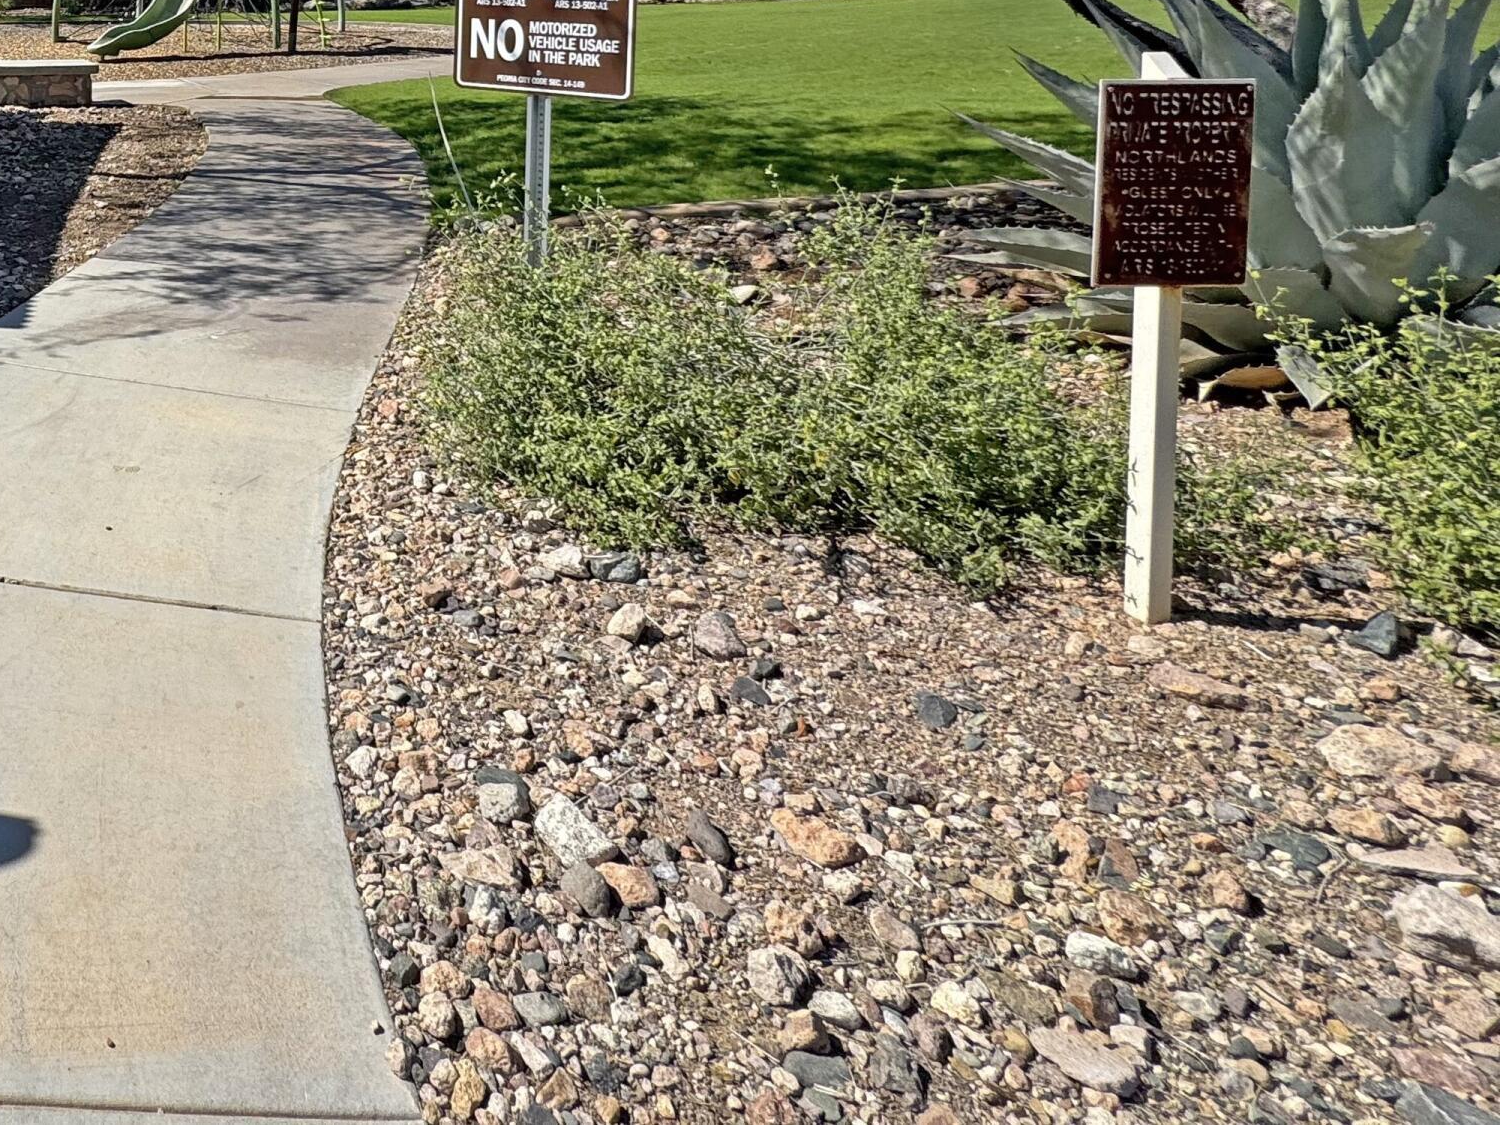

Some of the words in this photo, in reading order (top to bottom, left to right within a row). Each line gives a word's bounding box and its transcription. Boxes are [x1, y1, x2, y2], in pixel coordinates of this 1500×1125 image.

[554, 0, 570, 9] ARS
[528, 21, 597, 37] MOTORIZED
[470, 18, 525, 62] NO
[528, 36, 577, 51] VEHICLE
[579, 40, 620, 54] USAGE
[528, 50, 541, 63] IN
[543, 51, 566, 65] THE
[568, 53, 601, 68] PARK
[518, 76, 531, 84] CITY
[531, 77, 548, 85] CODE
